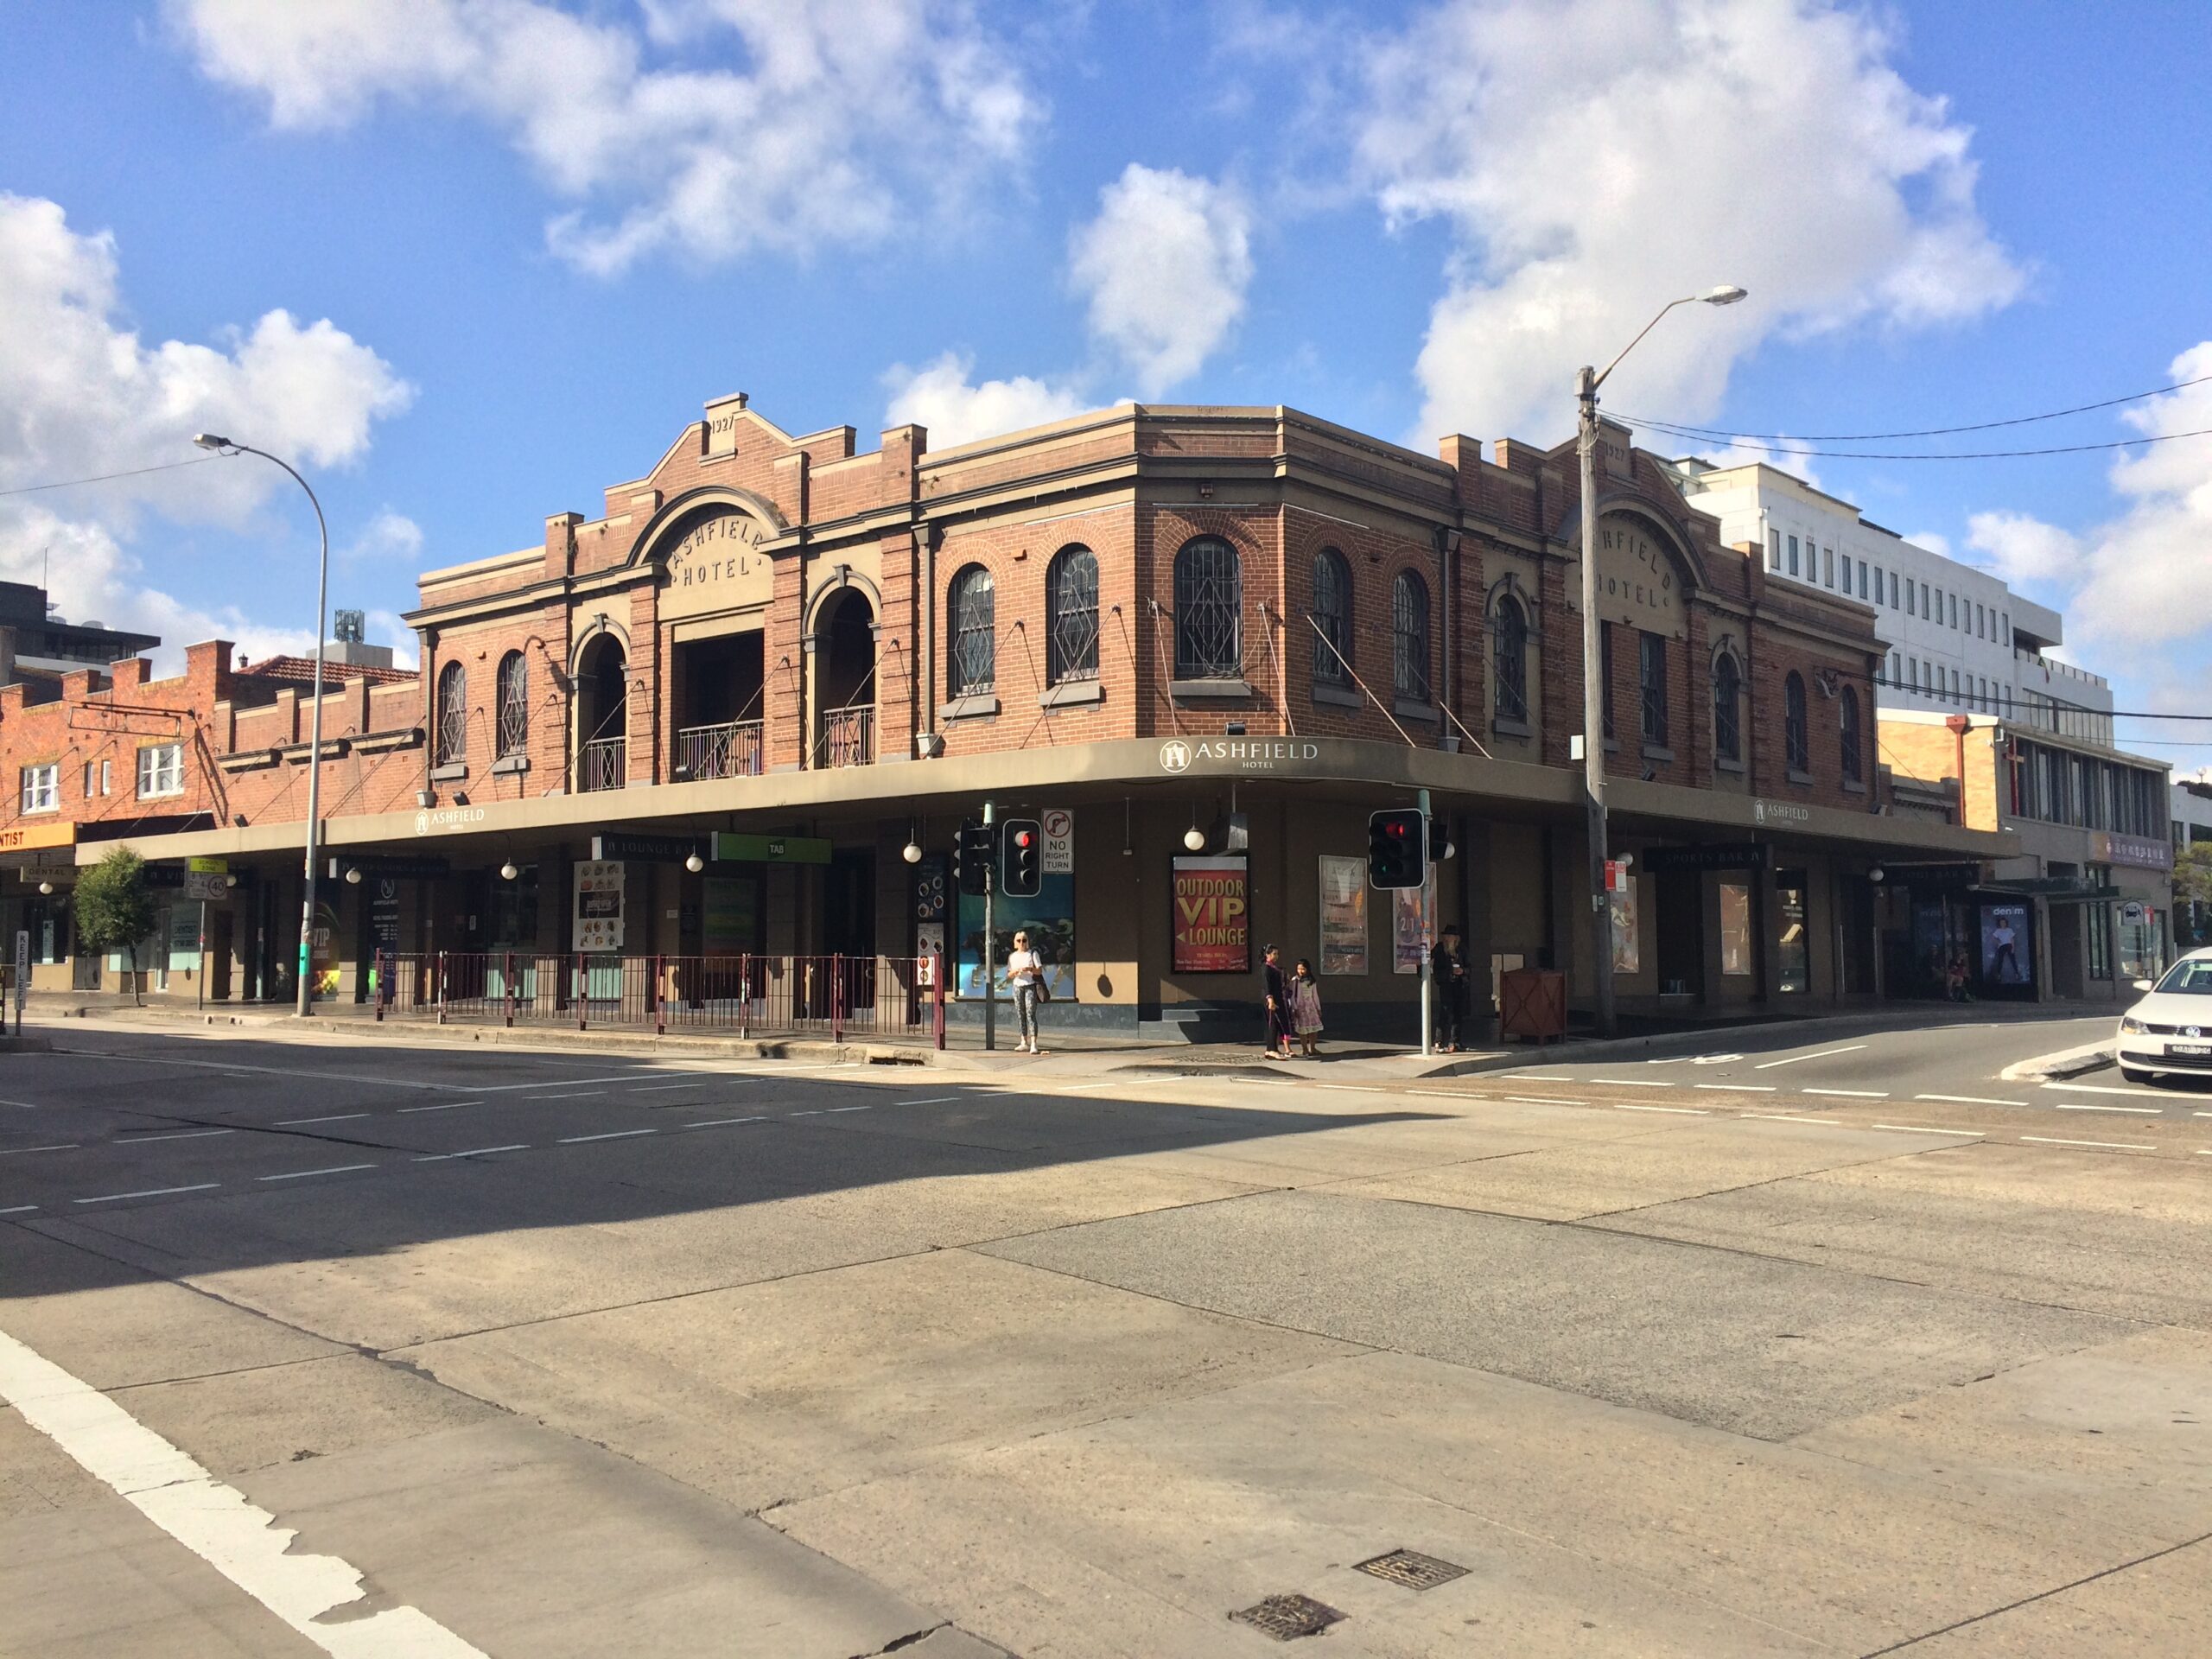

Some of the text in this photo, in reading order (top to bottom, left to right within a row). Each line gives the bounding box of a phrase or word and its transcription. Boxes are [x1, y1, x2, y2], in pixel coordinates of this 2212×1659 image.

[711, 415, 734, 435] 1927
[1605, 442, 1624, 462] 1927
[671, 519, 764, 569] ASHFIELD
[1578, 530, 1671, 590] HFIELD
[683, 556, 750, 586] HOTEL
[1195, 742, 1319, 760] ASHFIELD
[431, 809, 485, 824] ASHFIELD
[1767, 804, 1808, 821] ASHFIELD
[622, 842, 671, 855] LOUNGE
[770, 844, 785, 855] TAB
[1049, 841, 1066, 850] NO
[1666, 851, 1744, 864] SPORTS BAR
[211, 881, 225, 892] 40
[1176, 878, 1244, 897] OUTDOOR
[1177, 898, 1245, 926] VIP
[313, 928, 330, 947] VIP
[1189, 927, 1245, 946] LOUNGE
